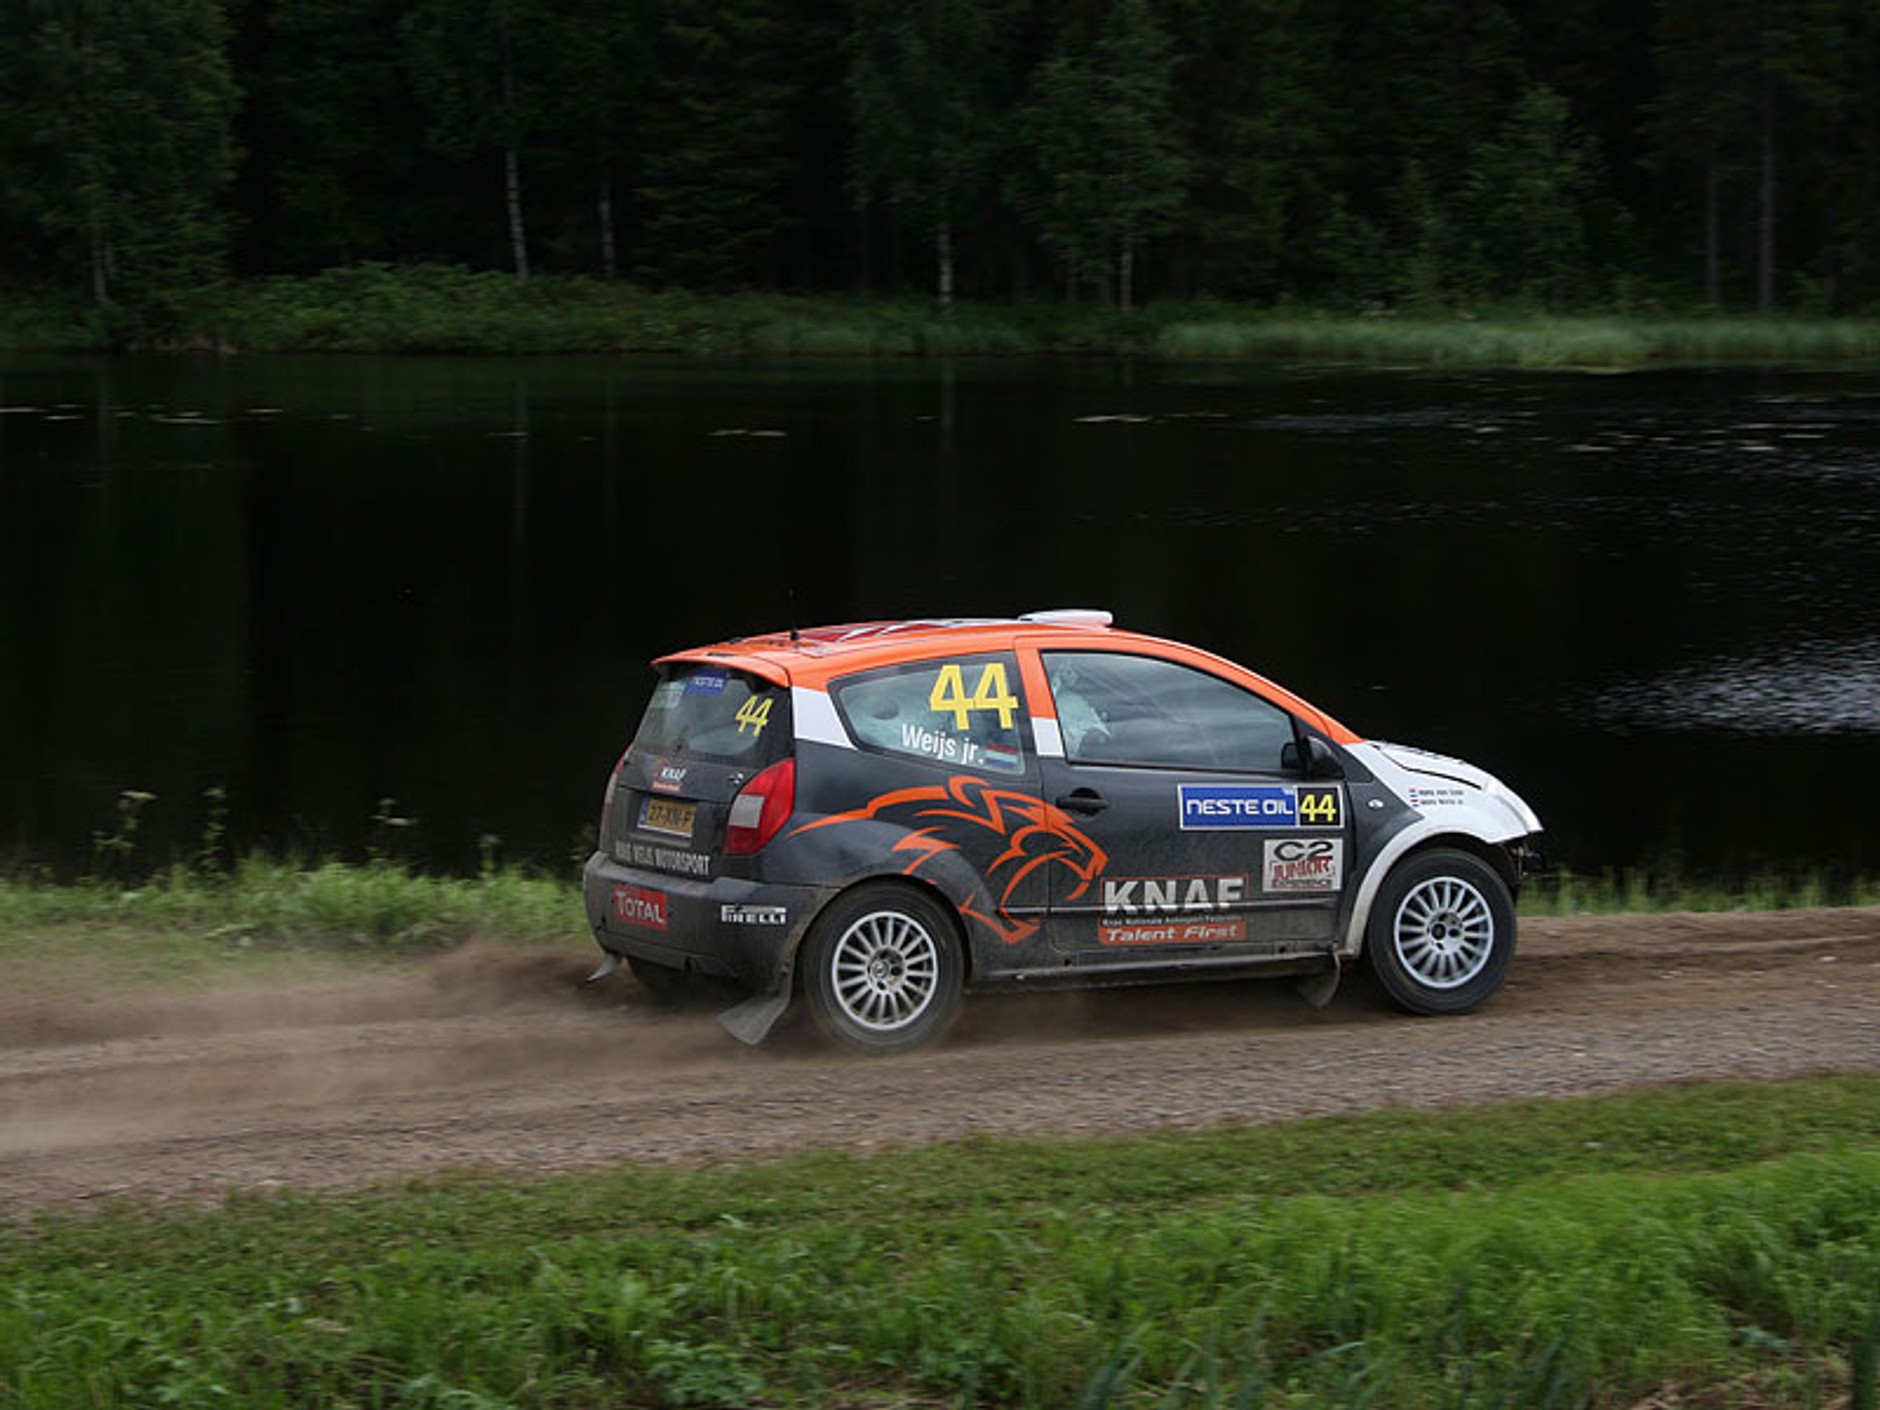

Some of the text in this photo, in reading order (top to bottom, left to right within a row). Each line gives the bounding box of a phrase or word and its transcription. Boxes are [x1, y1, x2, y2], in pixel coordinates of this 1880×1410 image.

[930, 662, 1019, 730] 44
[735, 695, 774, 737] 44
[902, 723, 985, 766] Weijs jr.
[1186, 793, 1336, 823] NESTE OIL 44
[655, 848, 711, 876] MOTORSPORT
[1274, 841, 1334, 861] C2
[615, 889, 666, 924] TOTAL
[1104, 878, 1244, 913] KNAF
[722, 904, 787, 924] PIRELLI
[1107, 925, 1238, 942] Talent First
